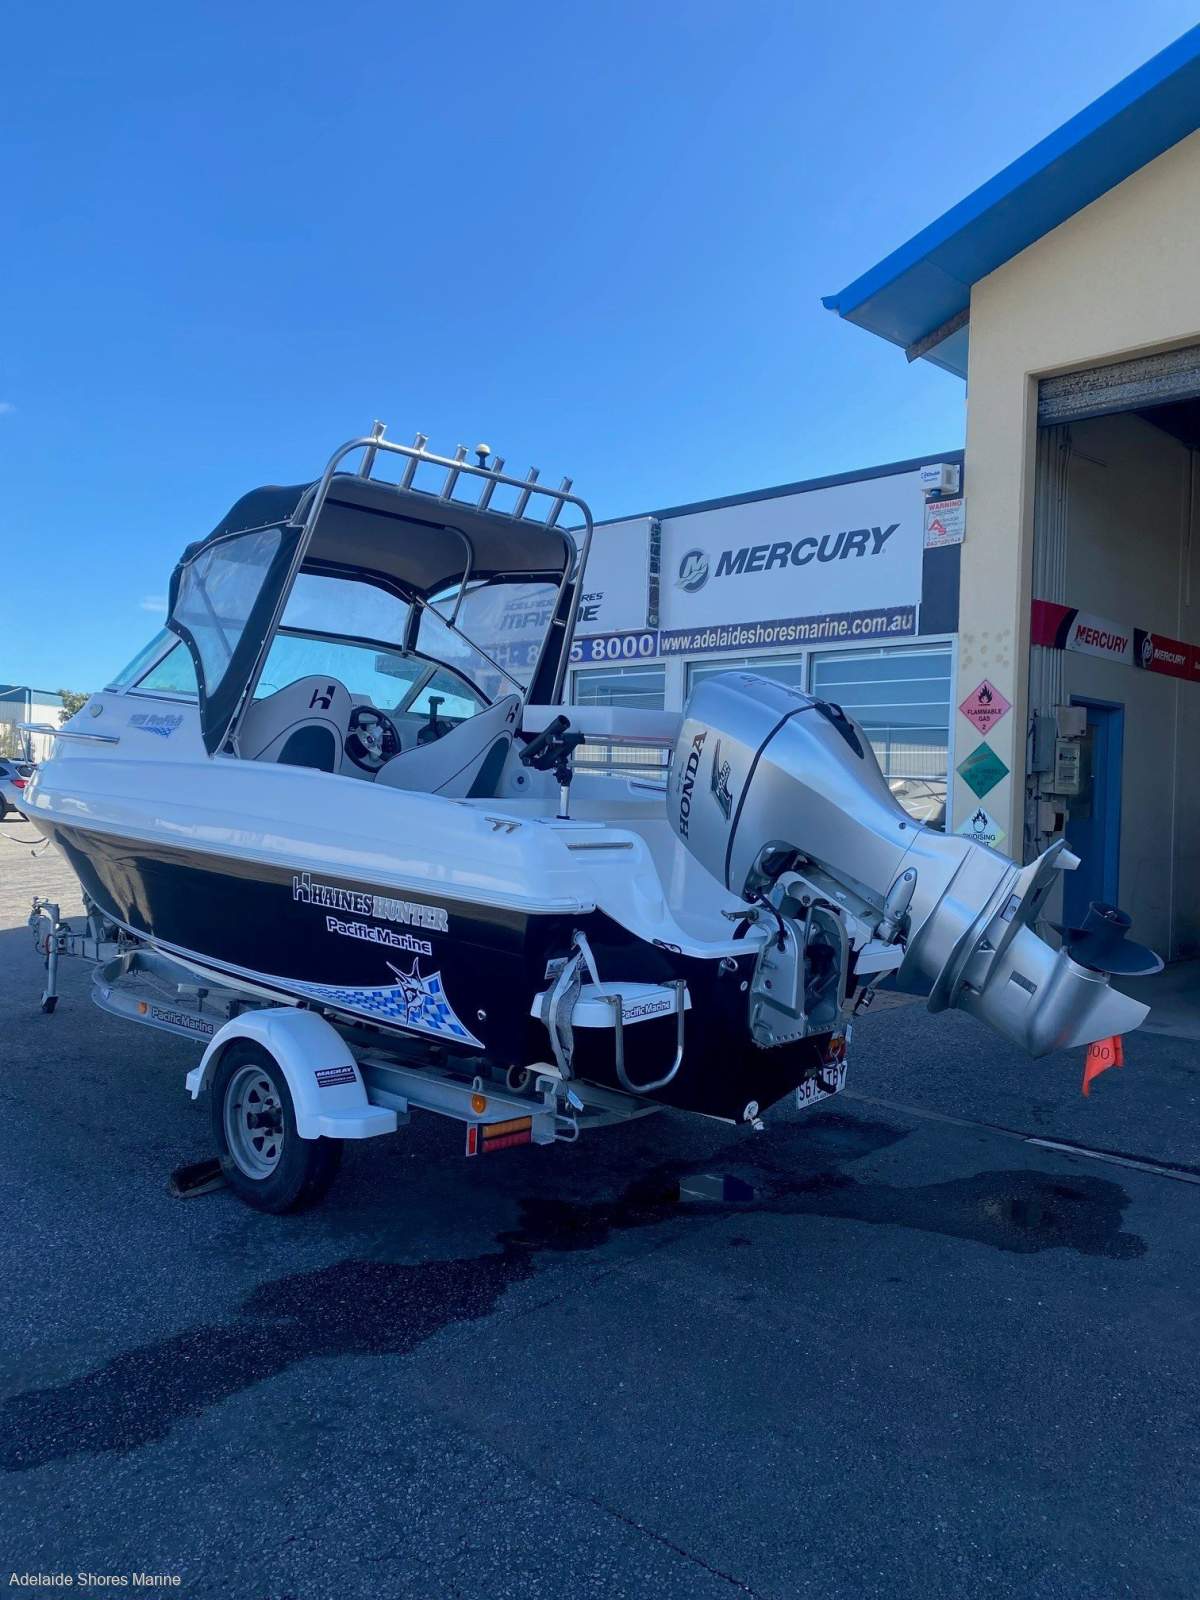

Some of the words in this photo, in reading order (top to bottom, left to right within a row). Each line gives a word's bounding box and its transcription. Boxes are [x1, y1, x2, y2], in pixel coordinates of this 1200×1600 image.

[928, 500, 962, 511] WARNING
[714, 523, 901, 578] MERCURY
[592, 634, 654, 660] 8000
[661, 613, 914, 651] www.adelaideshoresmarine.com.au
[1075, 624, 1129, 654] MERCURY
[1154, 648, 1186, 665] MERCURY
[967, 708, 1002, 716] FLAMMABLE
[679, 731, 708, 840] HONDA
[311, 884, 374, 916] HAINES
[372, 896, 449, 932] HUNTER
[326, 916, 378, 941] Pacific
[376, 927, 433, 955] Marine
